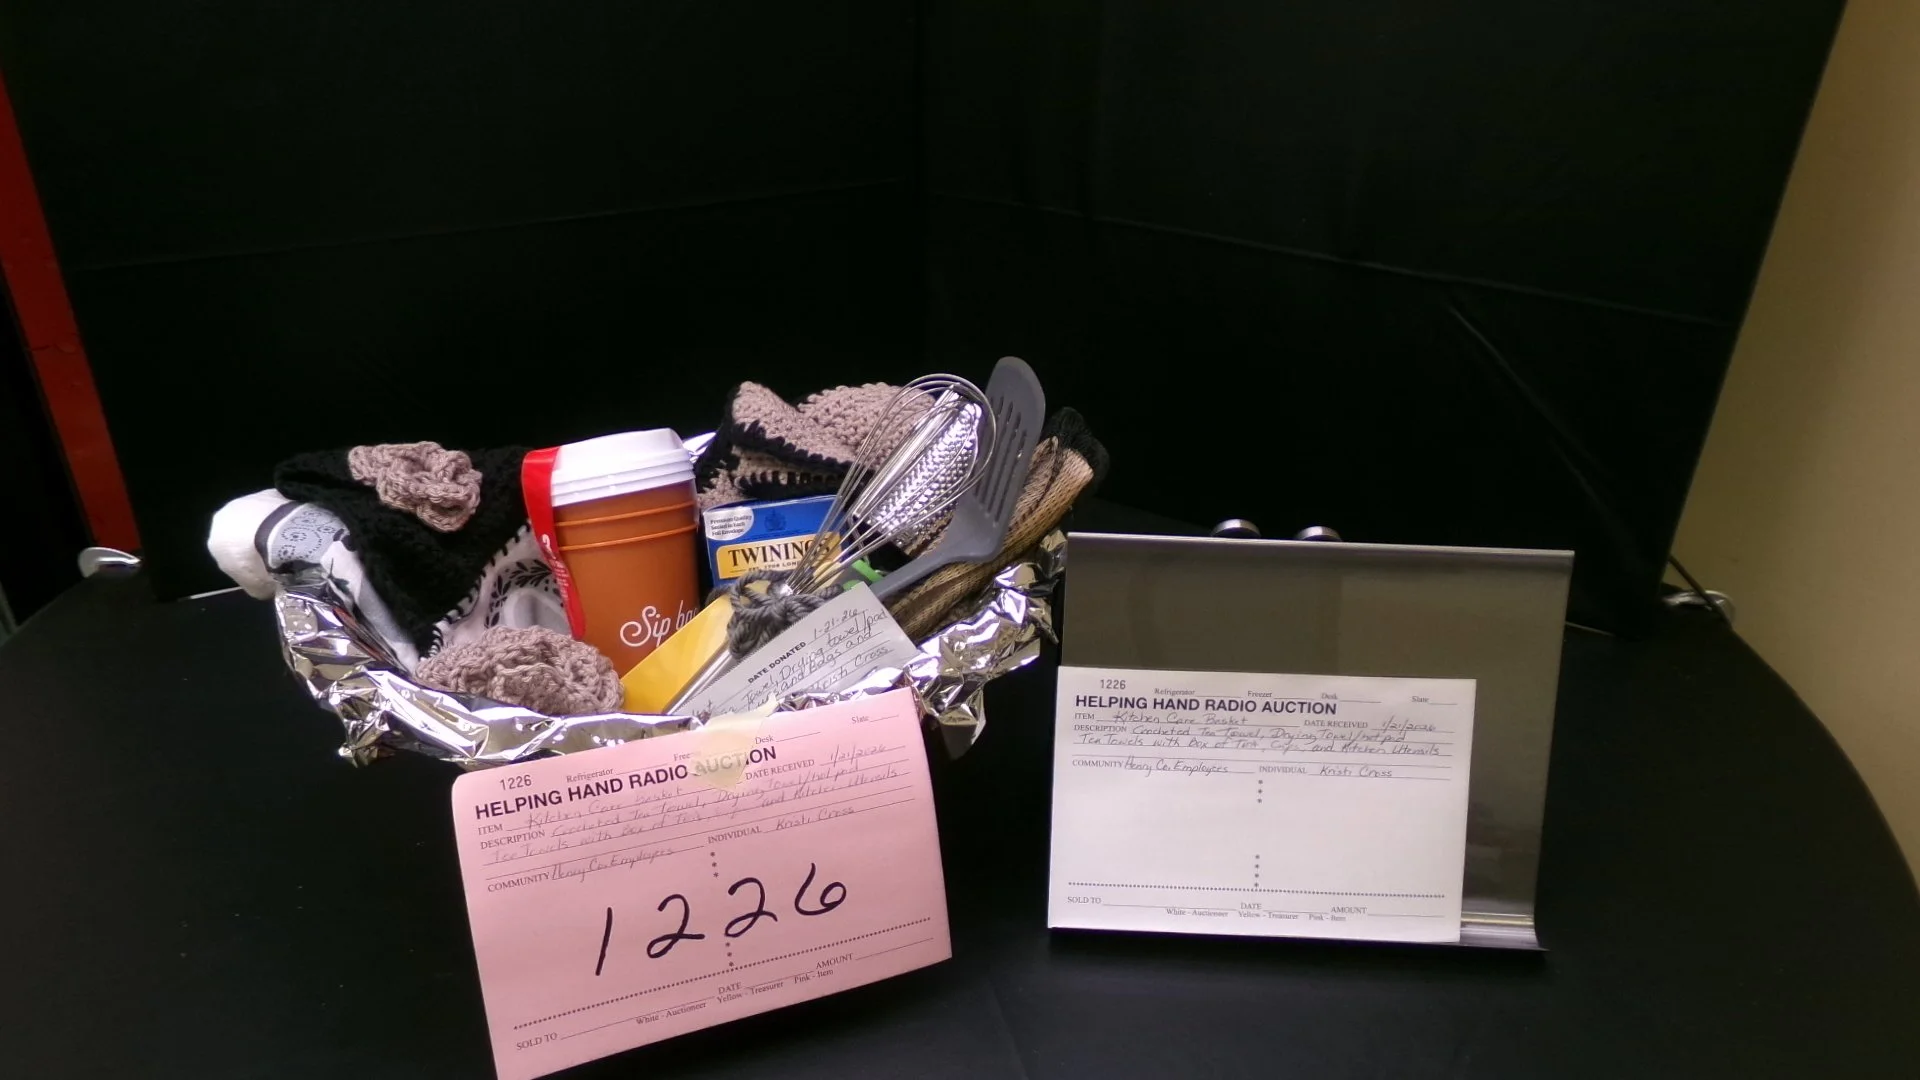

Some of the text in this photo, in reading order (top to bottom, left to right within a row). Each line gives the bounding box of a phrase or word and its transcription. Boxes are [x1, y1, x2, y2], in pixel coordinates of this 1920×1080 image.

[620, 606, 671, 647] Sip
[748, 641, 807, 684] DATE DONATED
[855, 646, 889, 667] Cross
[1101, 679, 1126, 690] 1226
[1154, 688, 1195, 696] Refrigerator
[1247, 690, 1272, 698] Freezer
[1075, 695, 1337, 715] HELPING HAND RADIO AUCTION
[1113, 711, 1160, 724] Kitchen
[1304, 719, 1368, 729] DATE RECEIVED
[755, 735, 774, 745] Desk
[745, 758, 815, 781] DATE RECEIVED
[1072, 759, 1124, 768] COMMUNITY
[1259, 766, 1307, 774] INDIVIDUAL
[1359, 765, 1393, 777] Cross
[475, 745, 777, 820] HELPING HAND RADIO AUCTION
[499, 774, 532, 791] 1226
[566, 768, 613, 783] Refrigerator
[478, 823, 503, 836] ITEM
[708, 826, 762, 844] INDIVIDUAL
[480, 829, 545, 850] DESCRIPTION
[487, 872, 550, 893] COMMUNITY
[1067, 896, 1089, 904] SOLD
[1240, 902, 1262, 910] DATE
[1166, 908, 1186, 916] White
[1192, 909, 1229, 917] Auctioneer
[1330, 906, 1368, 914] AMOUNT
[595, 863, 847, 976] 1226
[816, 953, 854, 969] AMOUNT
[794, 973, 811, 984] Pink
[817, 969, 834, 979] Item
[717, 992, 742, 1004] Yellow
[750, 981, 784, 995] Treasurer
[718, 982, 742, 995] DATE
[636, 1014, 660, 1025] White
[666, 1002, 707, 1018] Auctioneer
[516, 1032, 557, 1050] SOLD TO
